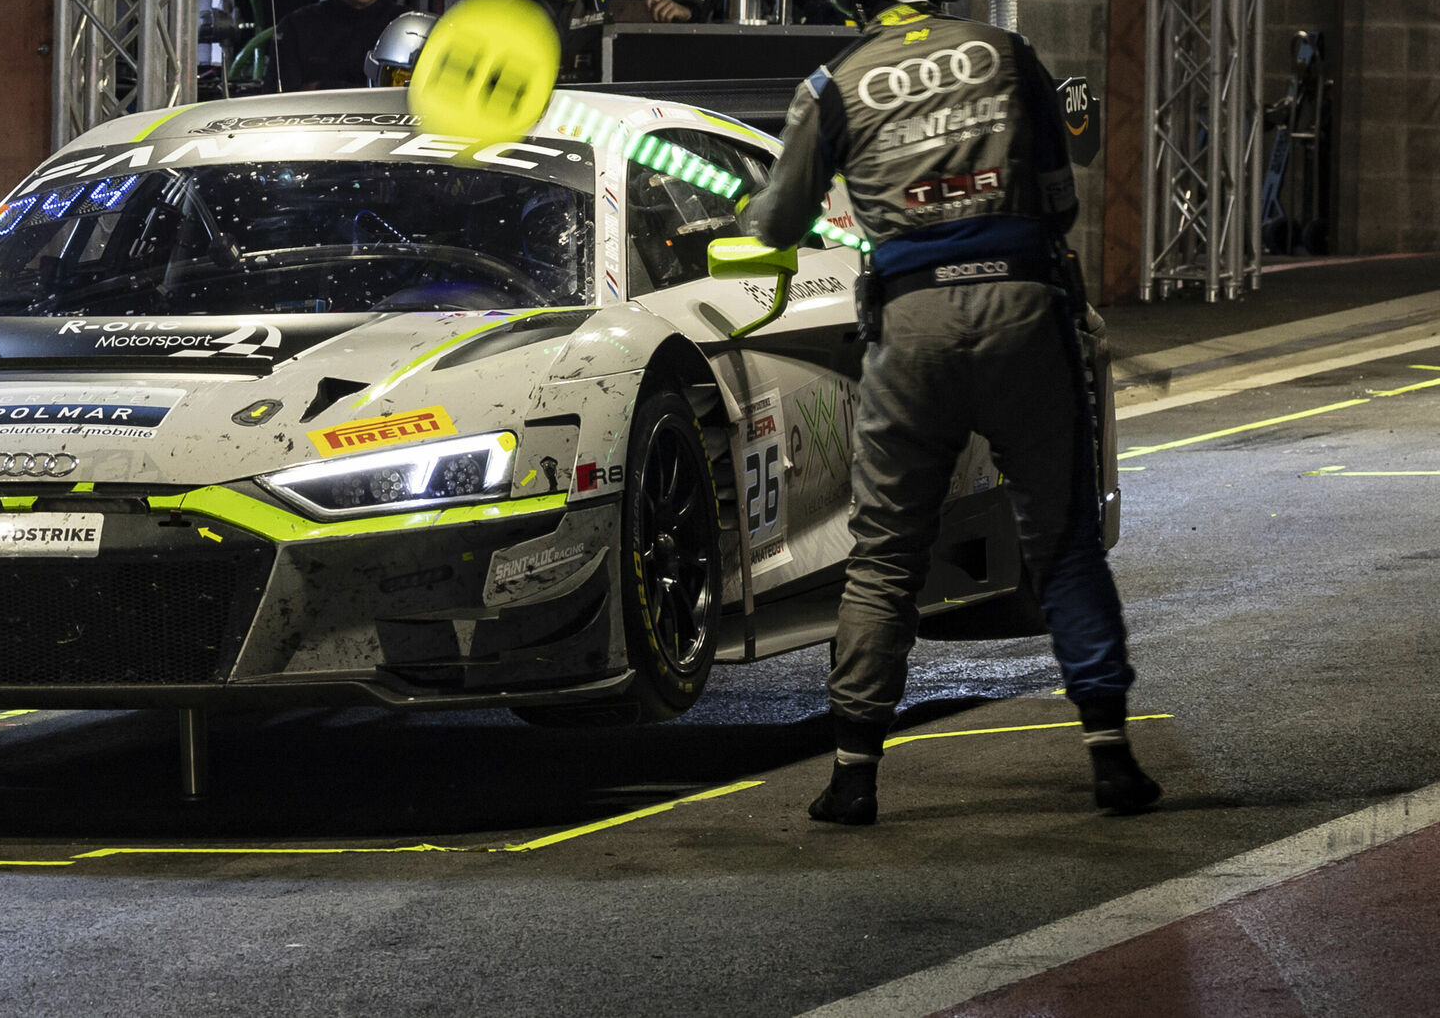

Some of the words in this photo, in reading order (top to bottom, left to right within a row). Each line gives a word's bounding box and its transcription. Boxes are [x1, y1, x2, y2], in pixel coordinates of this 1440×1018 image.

[1065, 82, 1088, 113] aws
[909, 172, 1000, 203] TLA
[95, 334, 213, 349] Motorsport
[82, 426, 154, 439] mobilité
[323, 412, 440, 450] PIRELLI
[588, 465, 624, 485] R8
[746, 443, 780, 535] 26
